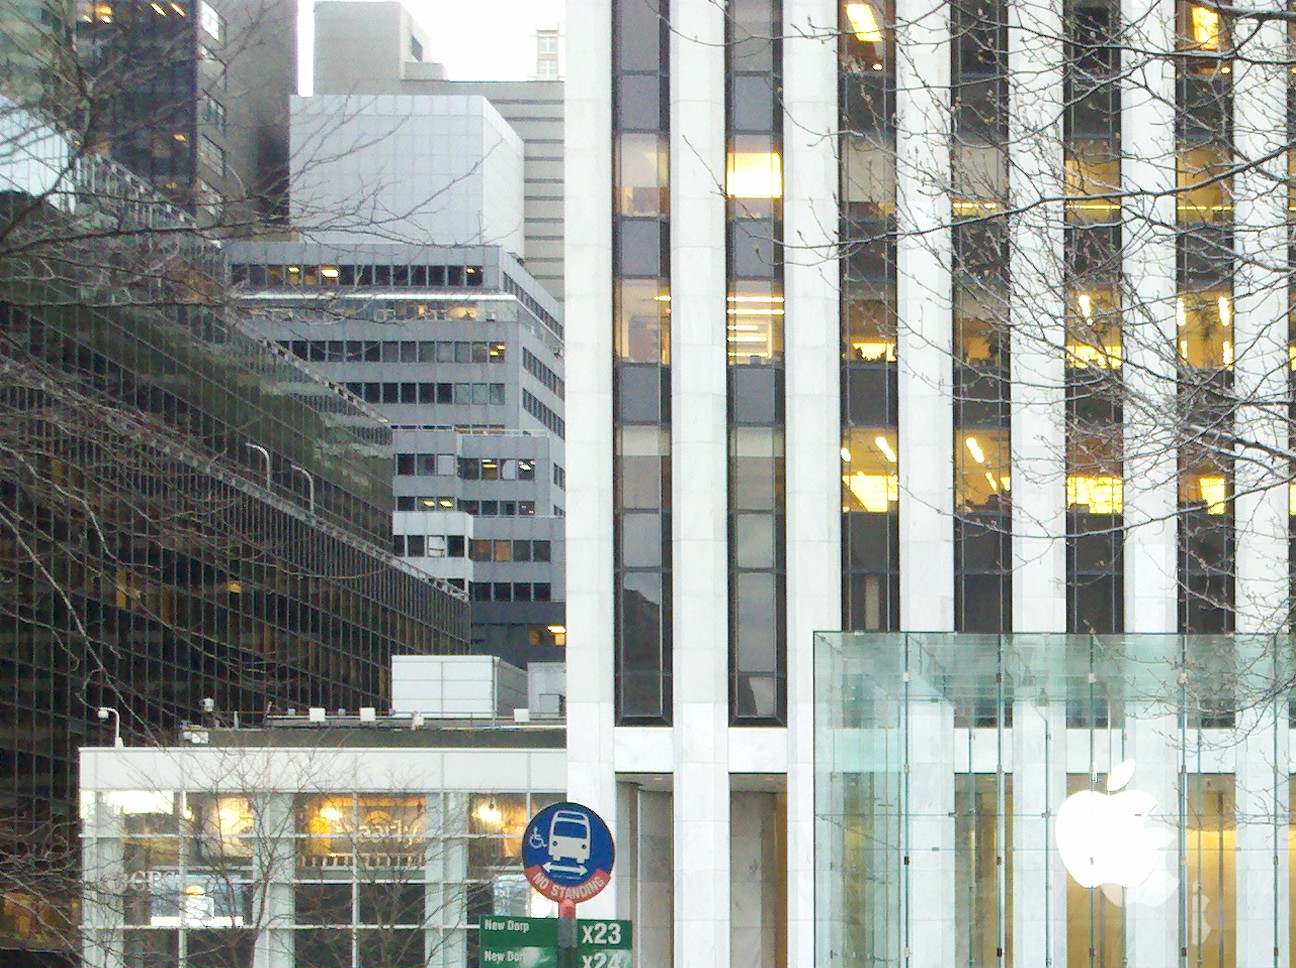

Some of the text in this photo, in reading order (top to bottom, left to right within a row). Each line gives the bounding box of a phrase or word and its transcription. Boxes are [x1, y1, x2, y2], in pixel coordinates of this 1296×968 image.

[533, 873, 605, 898] NO STANDING
[484, 919, 529, 933] New Dorp
[484, 951, 504, 962] New
